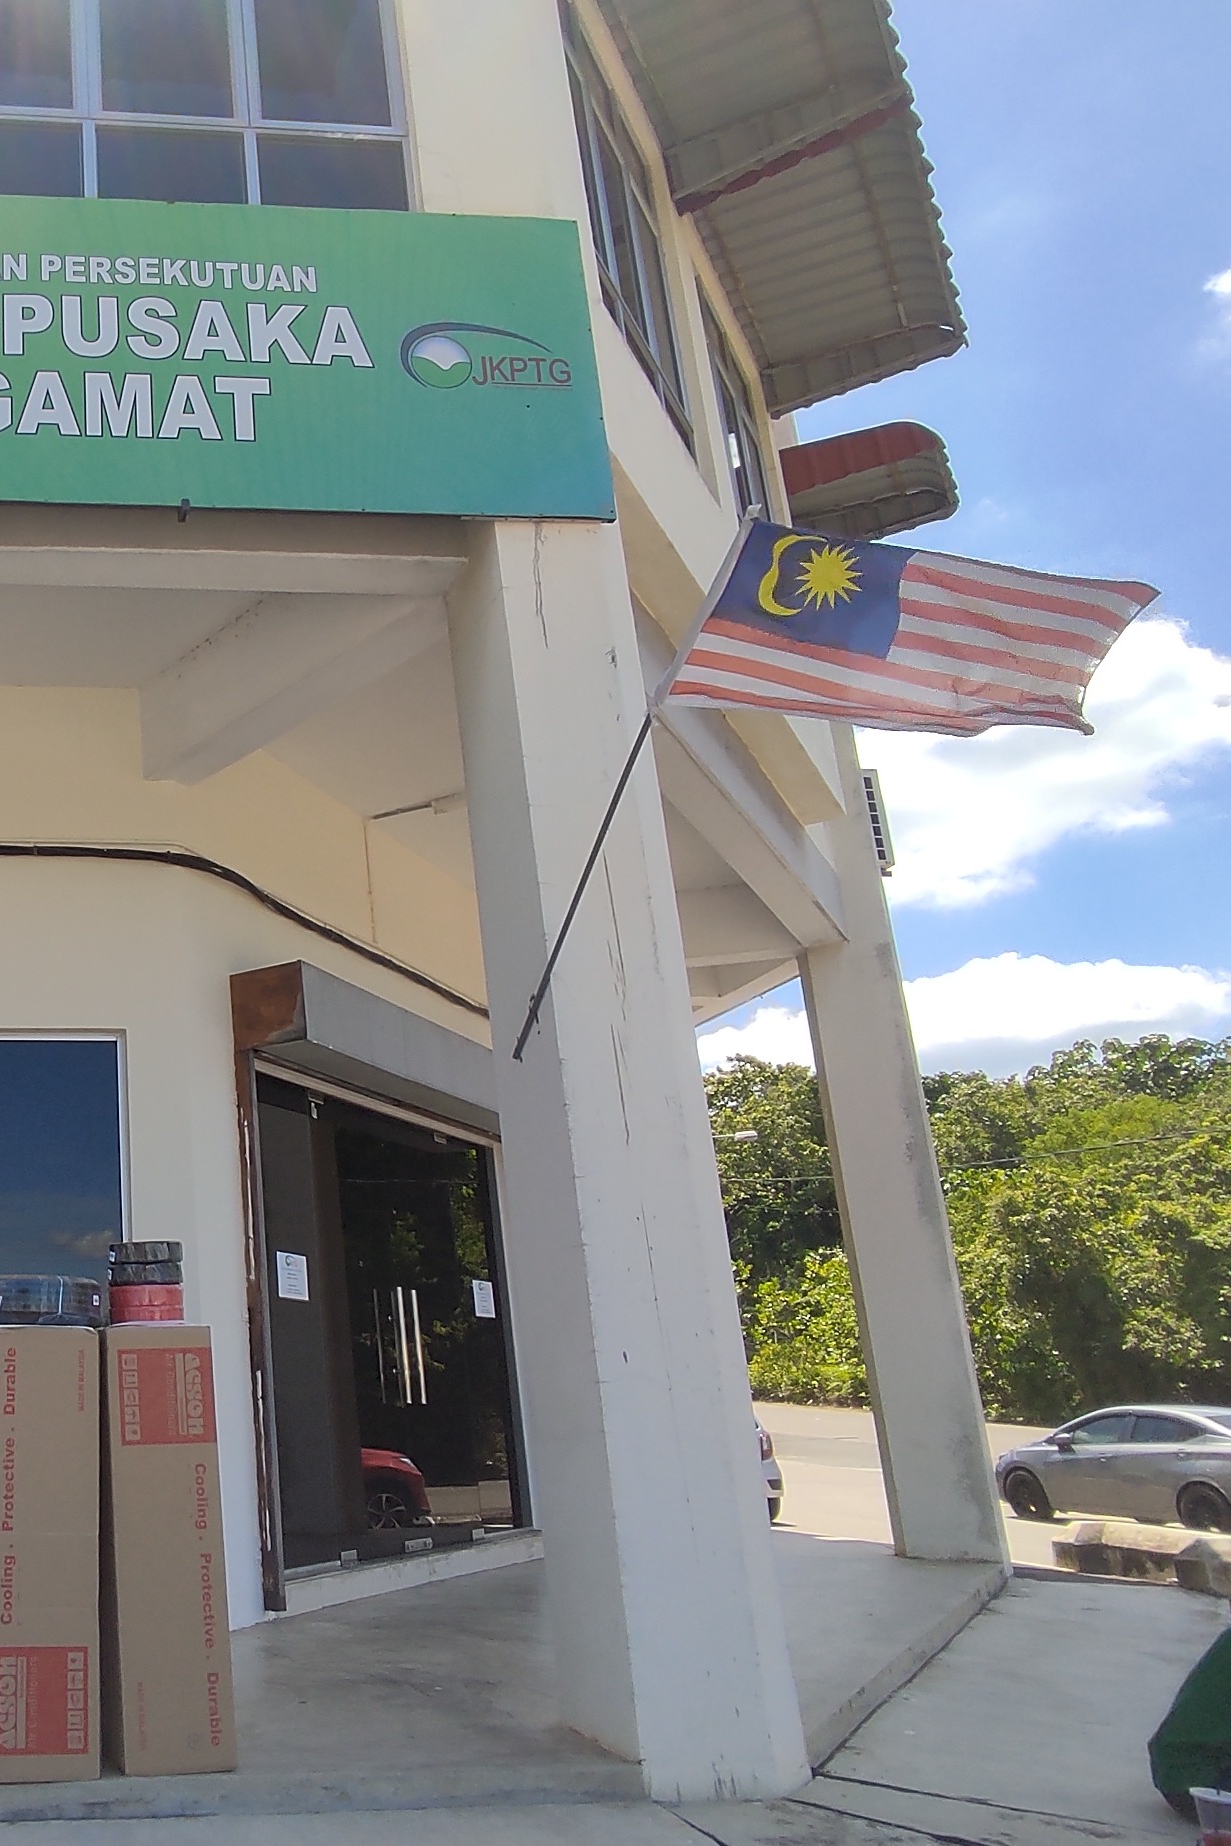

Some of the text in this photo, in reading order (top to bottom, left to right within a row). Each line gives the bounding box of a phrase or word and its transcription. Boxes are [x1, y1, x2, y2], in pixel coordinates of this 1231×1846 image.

[40, 254, 318, 293] PERSEKUTUAN
[3, 294, 375, 369] PUSAKA
[472, 355, 572, 386] JKPTG
[0, 1347, 16, 1625] Cooling Protective Durable
[194, 1463, 223, 1747] Cooling Protective Durable
